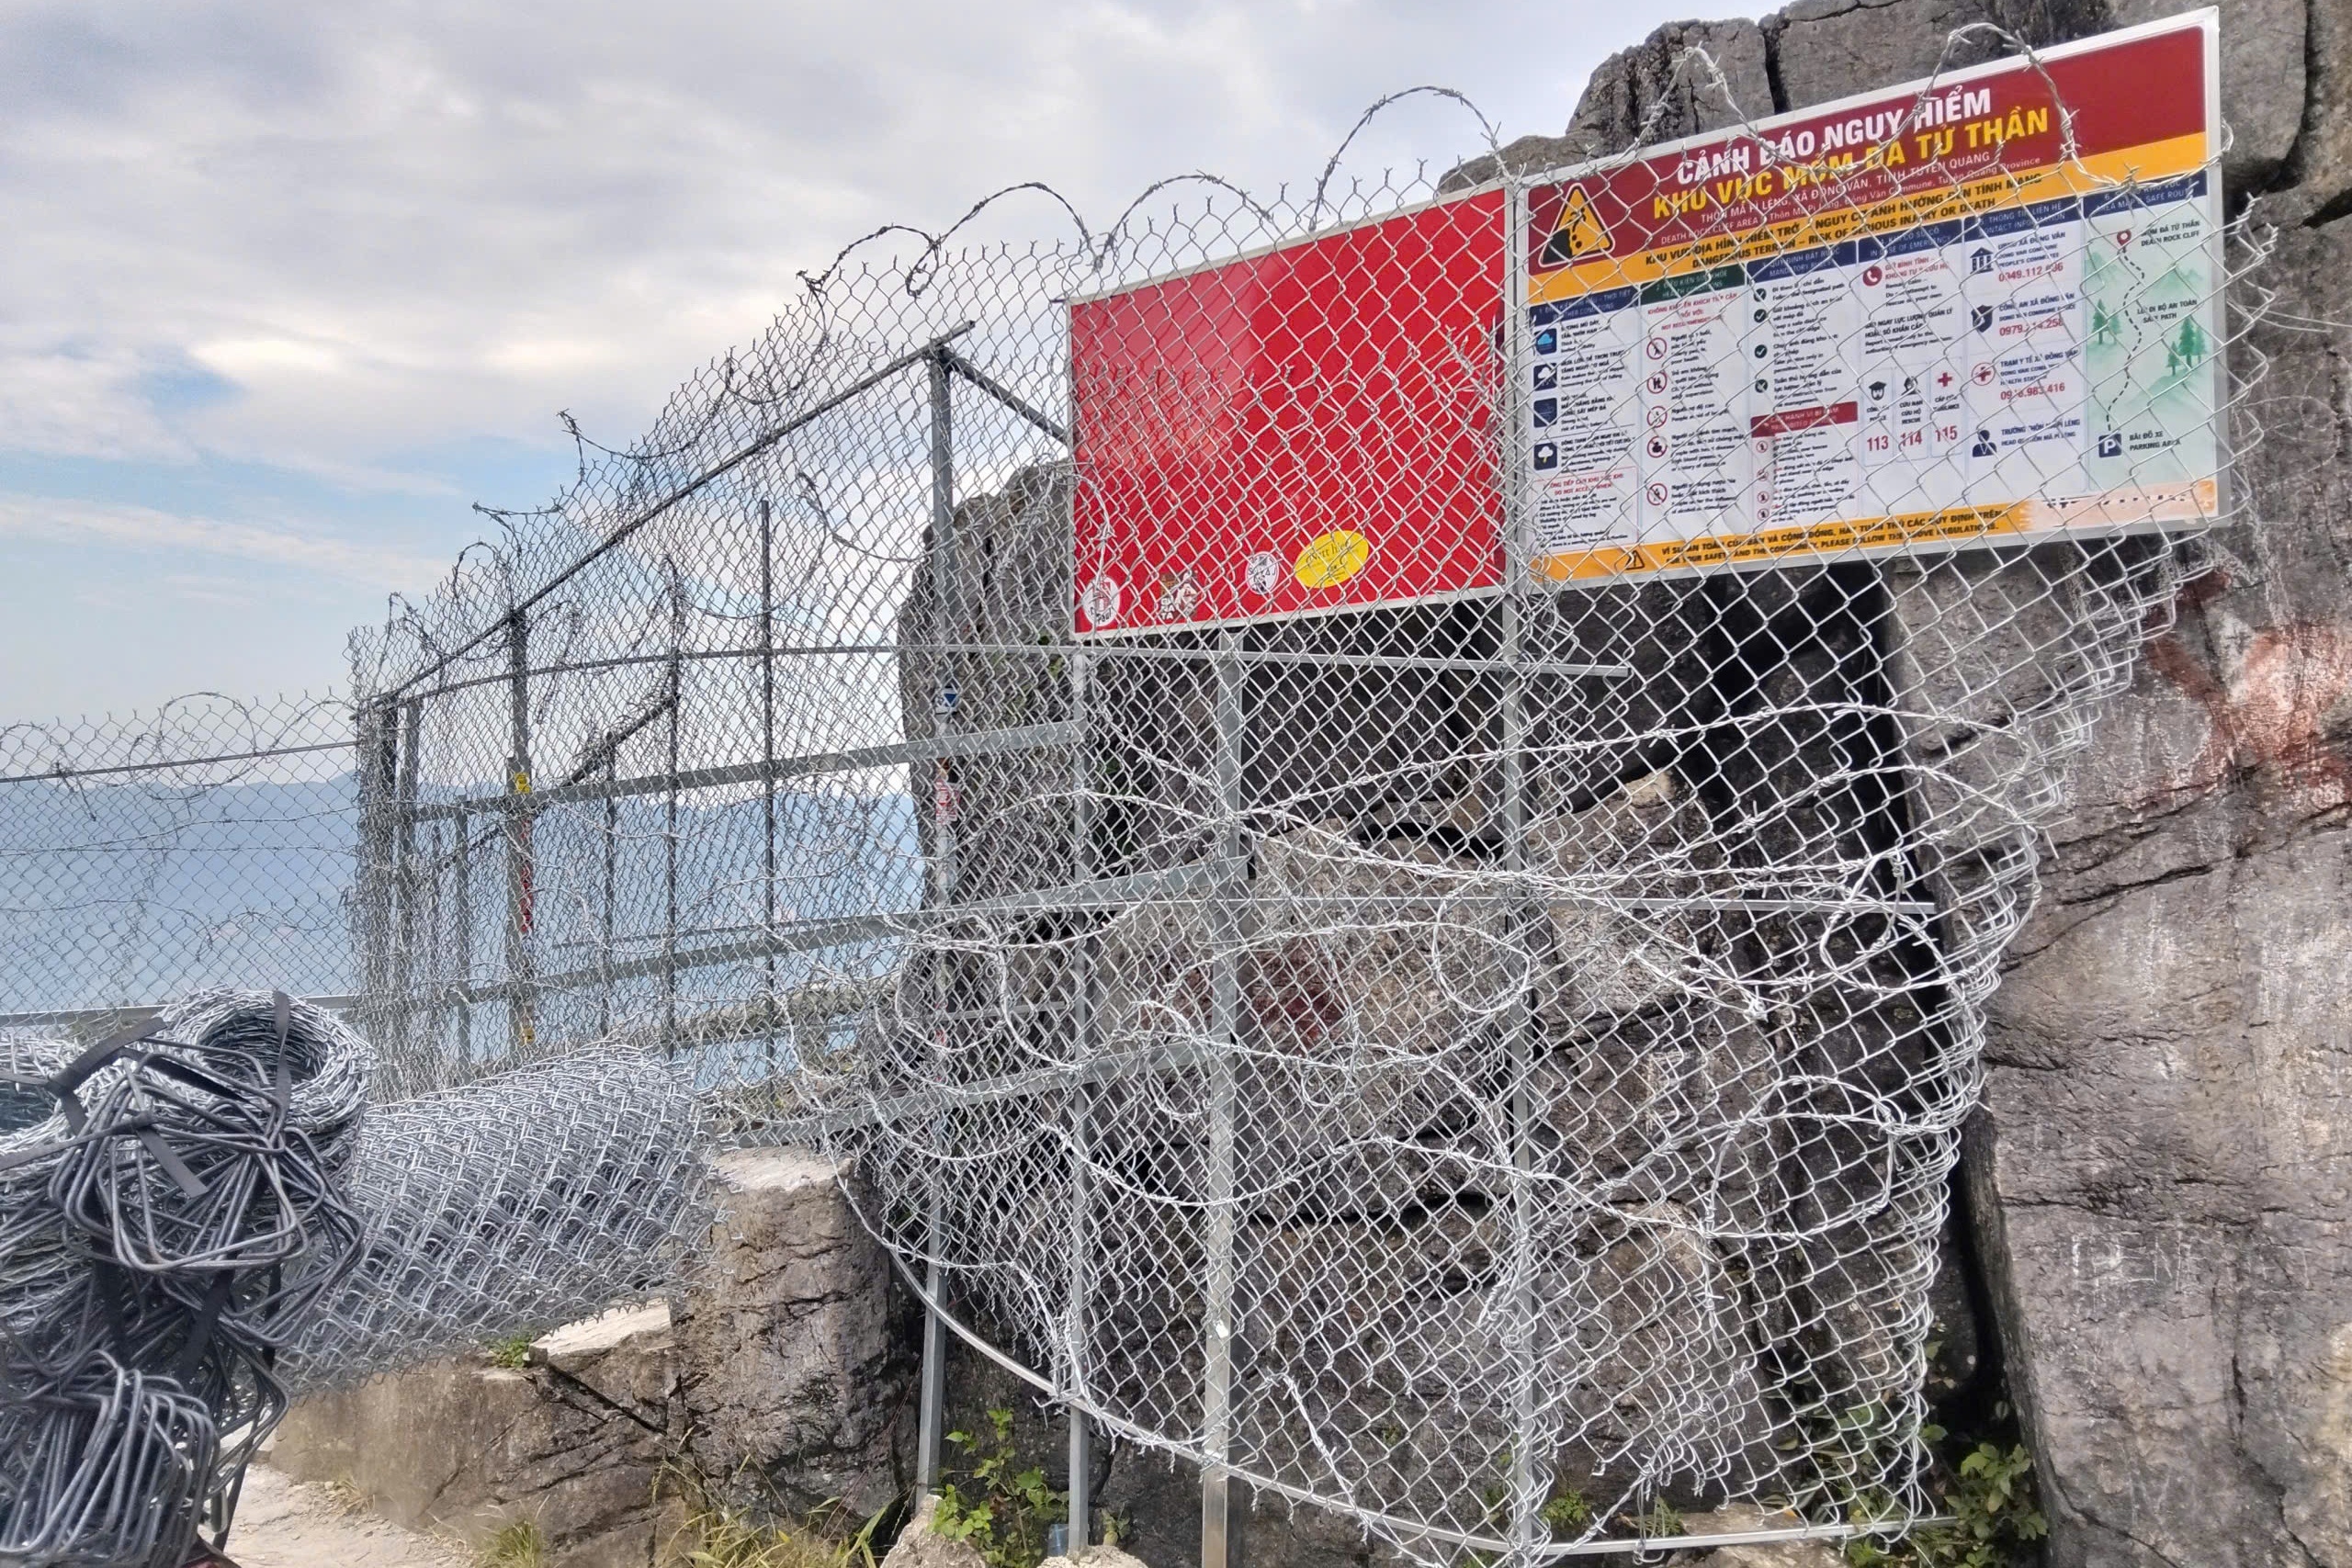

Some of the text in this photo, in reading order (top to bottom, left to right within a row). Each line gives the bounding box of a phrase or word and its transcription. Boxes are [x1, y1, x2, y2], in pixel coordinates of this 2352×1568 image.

[1677, 144, 1749, 186] CẢNH
[1824, 107, 1904, 152] NGUY
[1916, 84, 1991, 130] HIỂM
[1653, 185, 1707, 220] KHU
[1916, 122, 1955, 161] TỬ
[1963, 104, 2048, 150] THẦN
[1949, 150, 1989, 170] QUANG
[2145, 192, 2165, 203] SAFE
[1660, 231, 1686, 244] DEATH
[1736, 216, 1758, 228] AREA
[1888, 177, 1935, 197] Cmmune,
[1815, 213, 1848, 229] NGUY
[1834, 227, 1848, 239] OF
[1900, 209, 1937, 225] INJRY
[1940, 205, 1955, 217] OR
[1909, 233, 1951, 249] EMERGNCY
[2141, 230, 2199, 247] DEAH ROCK CLIFF
[1770, 262, 1809, 277] MANDTORY
[2160, 311, 2177, 321] PATH
[1999, 378, 2021, 386] HALTH
[1900, 429, 1922, 447] 114
[1934, 424, 1958, 443] 115
[1866, 434, 1889, 452] 113
[2103, 437, 2116, 454] P
[2129, 441, 2160, 451] PARKING
[1906, 516, 1926, 527] CÁC
[1703, 551, 1727, 560] SAFET
[1820, 537, 1850, 547] PLEASE
